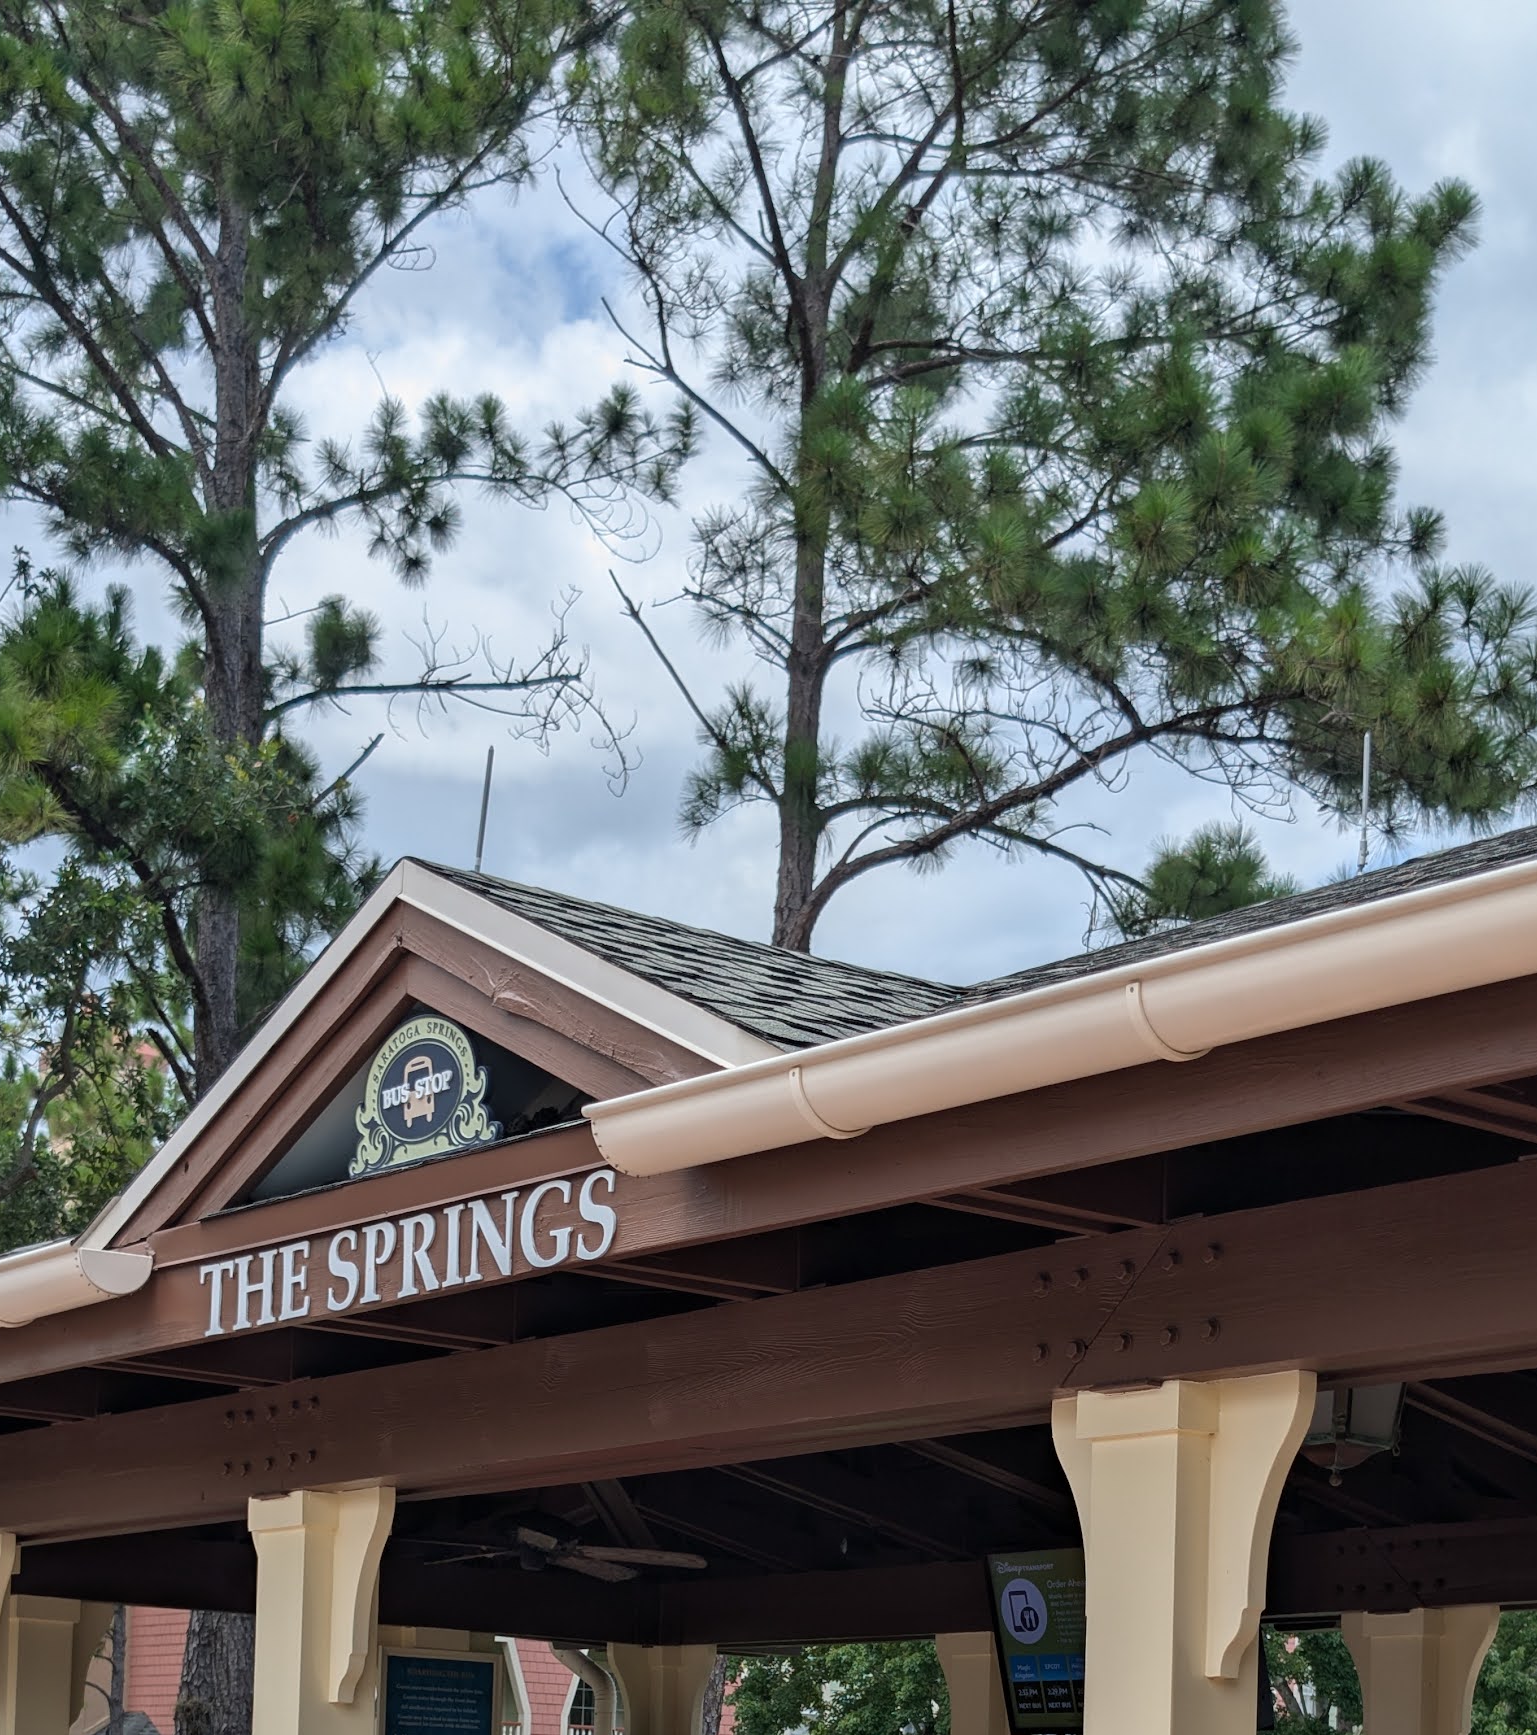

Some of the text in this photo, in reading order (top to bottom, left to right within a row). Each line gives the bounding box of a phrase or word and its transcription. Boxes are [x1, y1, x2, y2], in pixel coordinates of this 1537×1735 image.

[373, 1021, 468, 1084] SARATOGA SPRINGS
[382, 1070, 453, 1110] BUS STOP
[200, 1169, 618, 1337] THE SPRINGS
[1047, 1579, 1066, 1589] Order
